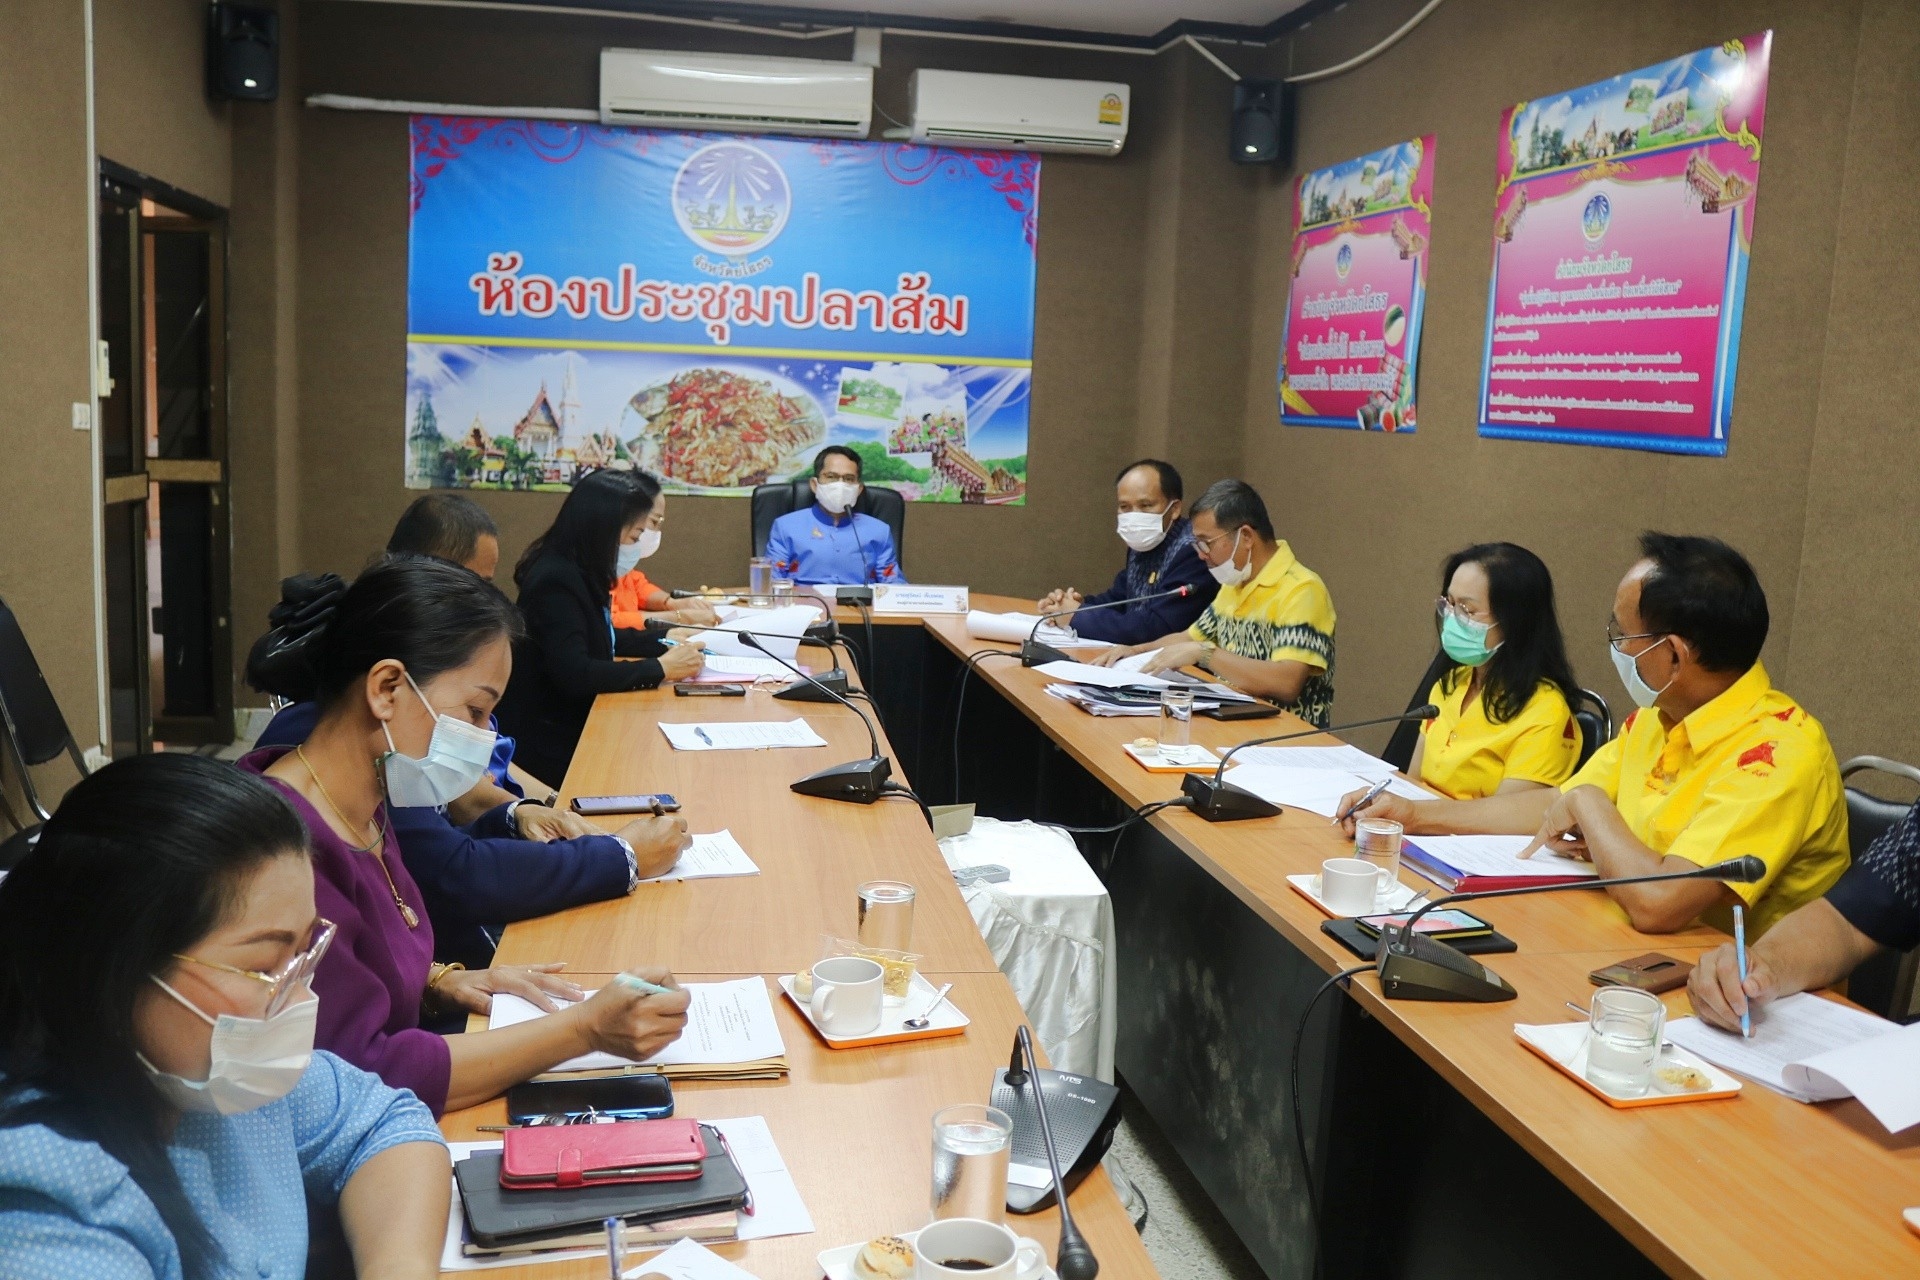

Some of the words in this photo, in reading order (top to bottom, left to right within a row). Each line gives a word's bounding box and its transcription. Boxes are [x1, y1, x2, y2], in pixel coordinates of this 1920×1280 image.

[470, 251, 969, 345] ห้องประชุมปลาส้ม
